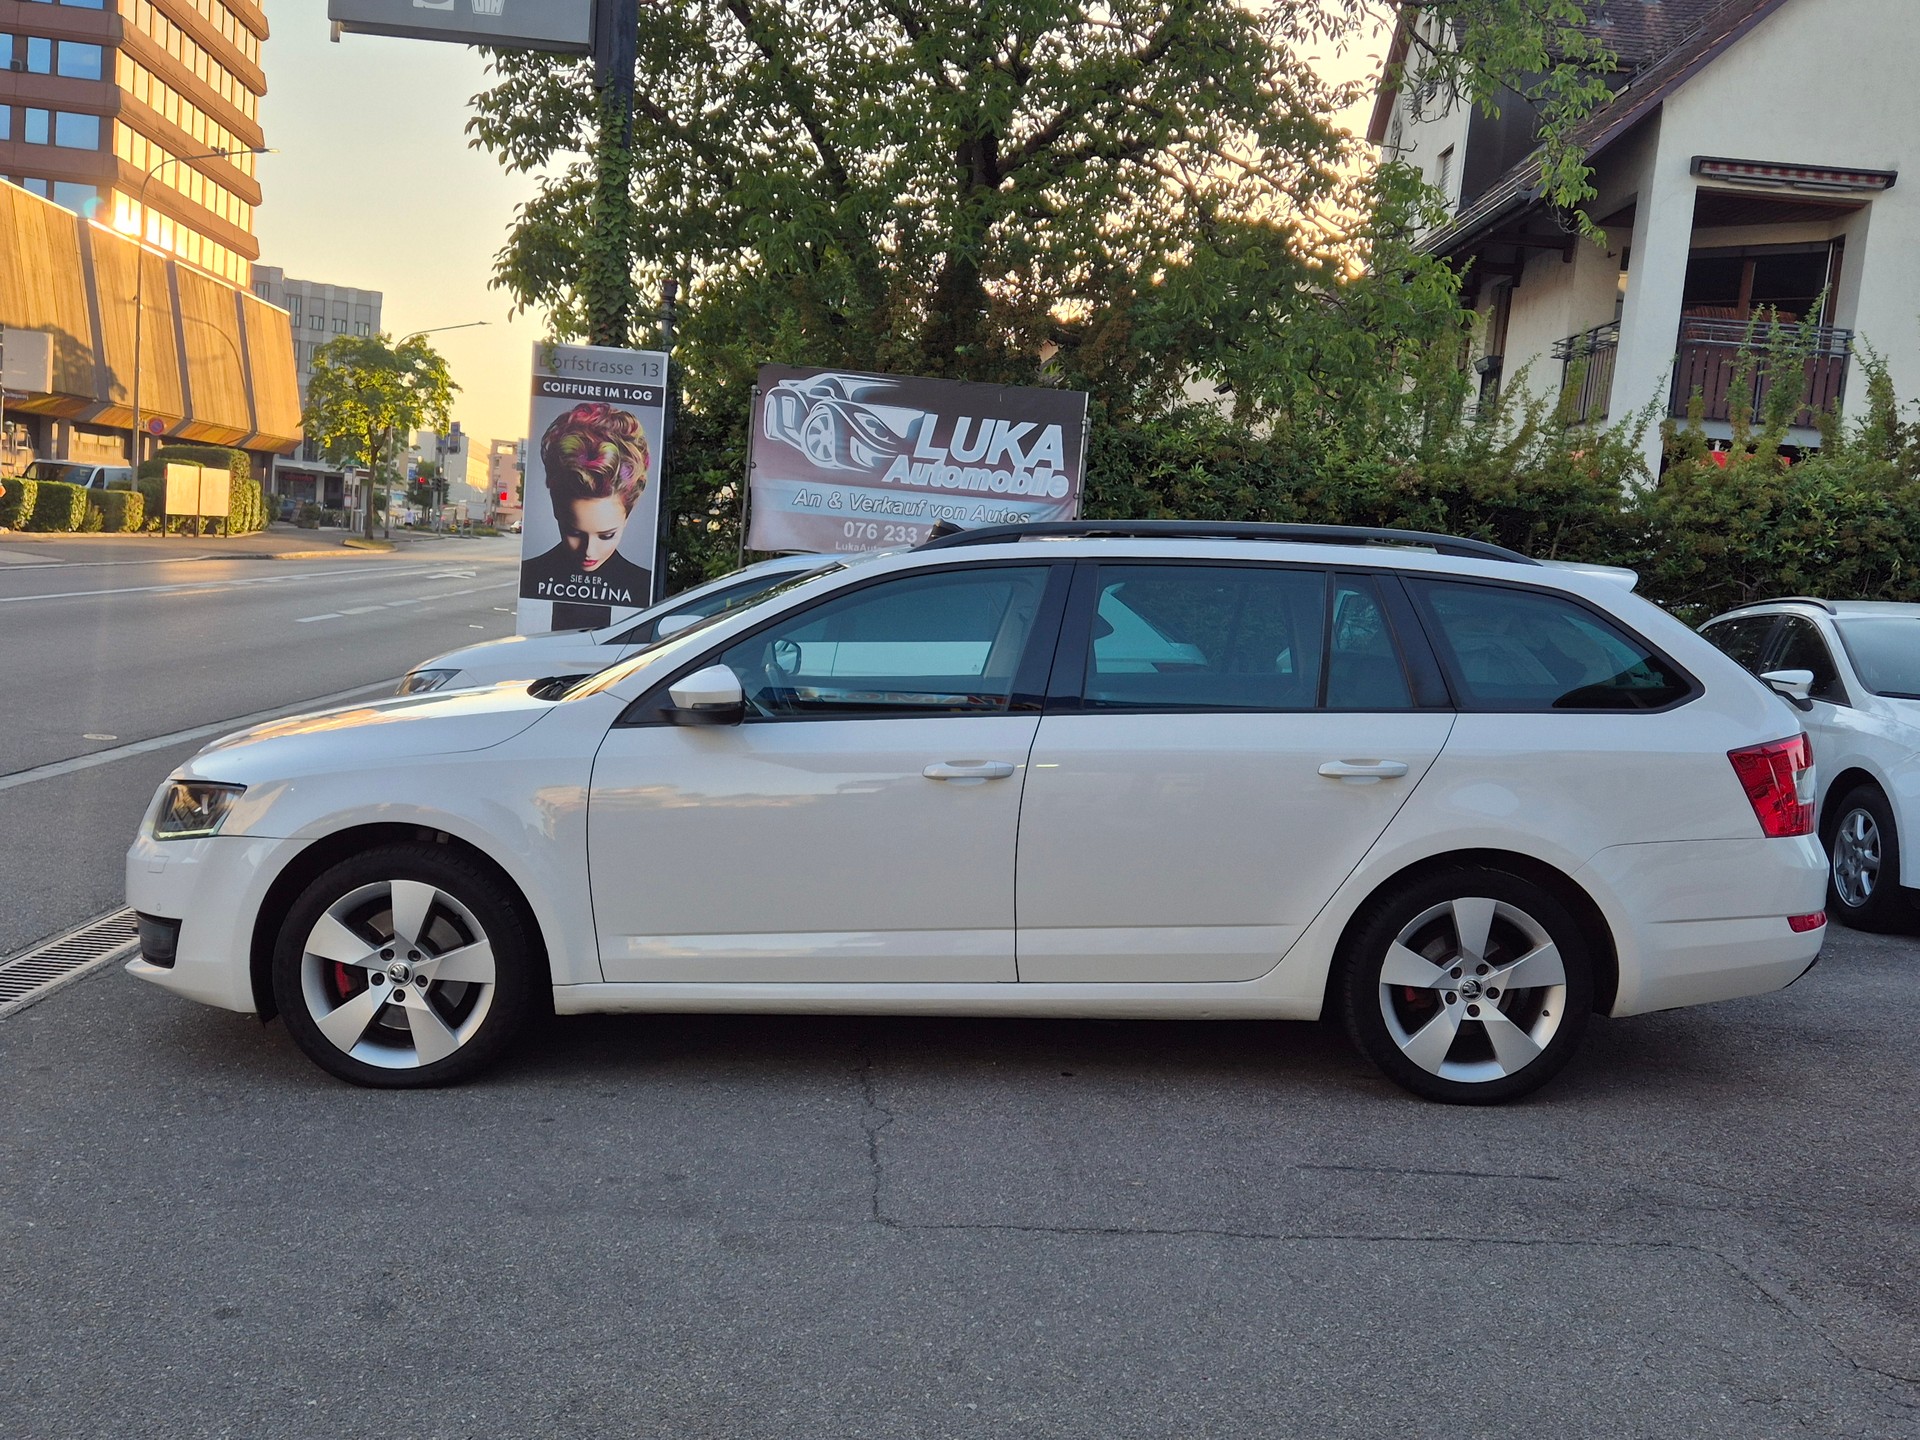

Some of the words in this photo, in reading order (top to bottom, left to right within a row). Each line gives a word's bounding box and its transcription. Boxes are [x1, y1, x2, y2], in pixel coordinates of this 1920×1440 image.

[641, 362, 659, 377] 13
[543, 381, 601, 396] COIFFURE
[604, 387, 620, 398] IM
[623, 389, 653, 400] 1.OG
[913, 413, 1065, 471] LUKA
[881, 454, 1069, 498] Automobile
[792, 488, 822, 507] An
[827, 491, 842, 509] &
[849, 492, 926, 516] Verkauf
[929, 506, 967, 520] von
[970, 505, 1030, 524] Autos
[843, 521, 878, 539] 076
[883, 524, 918, 543] 233
[835, 541, 878, 552] LukaAut
[570, 574, 583, 583] SIE
[583, 575, 591, 584] &
[592, 576, 602, 585] ER
